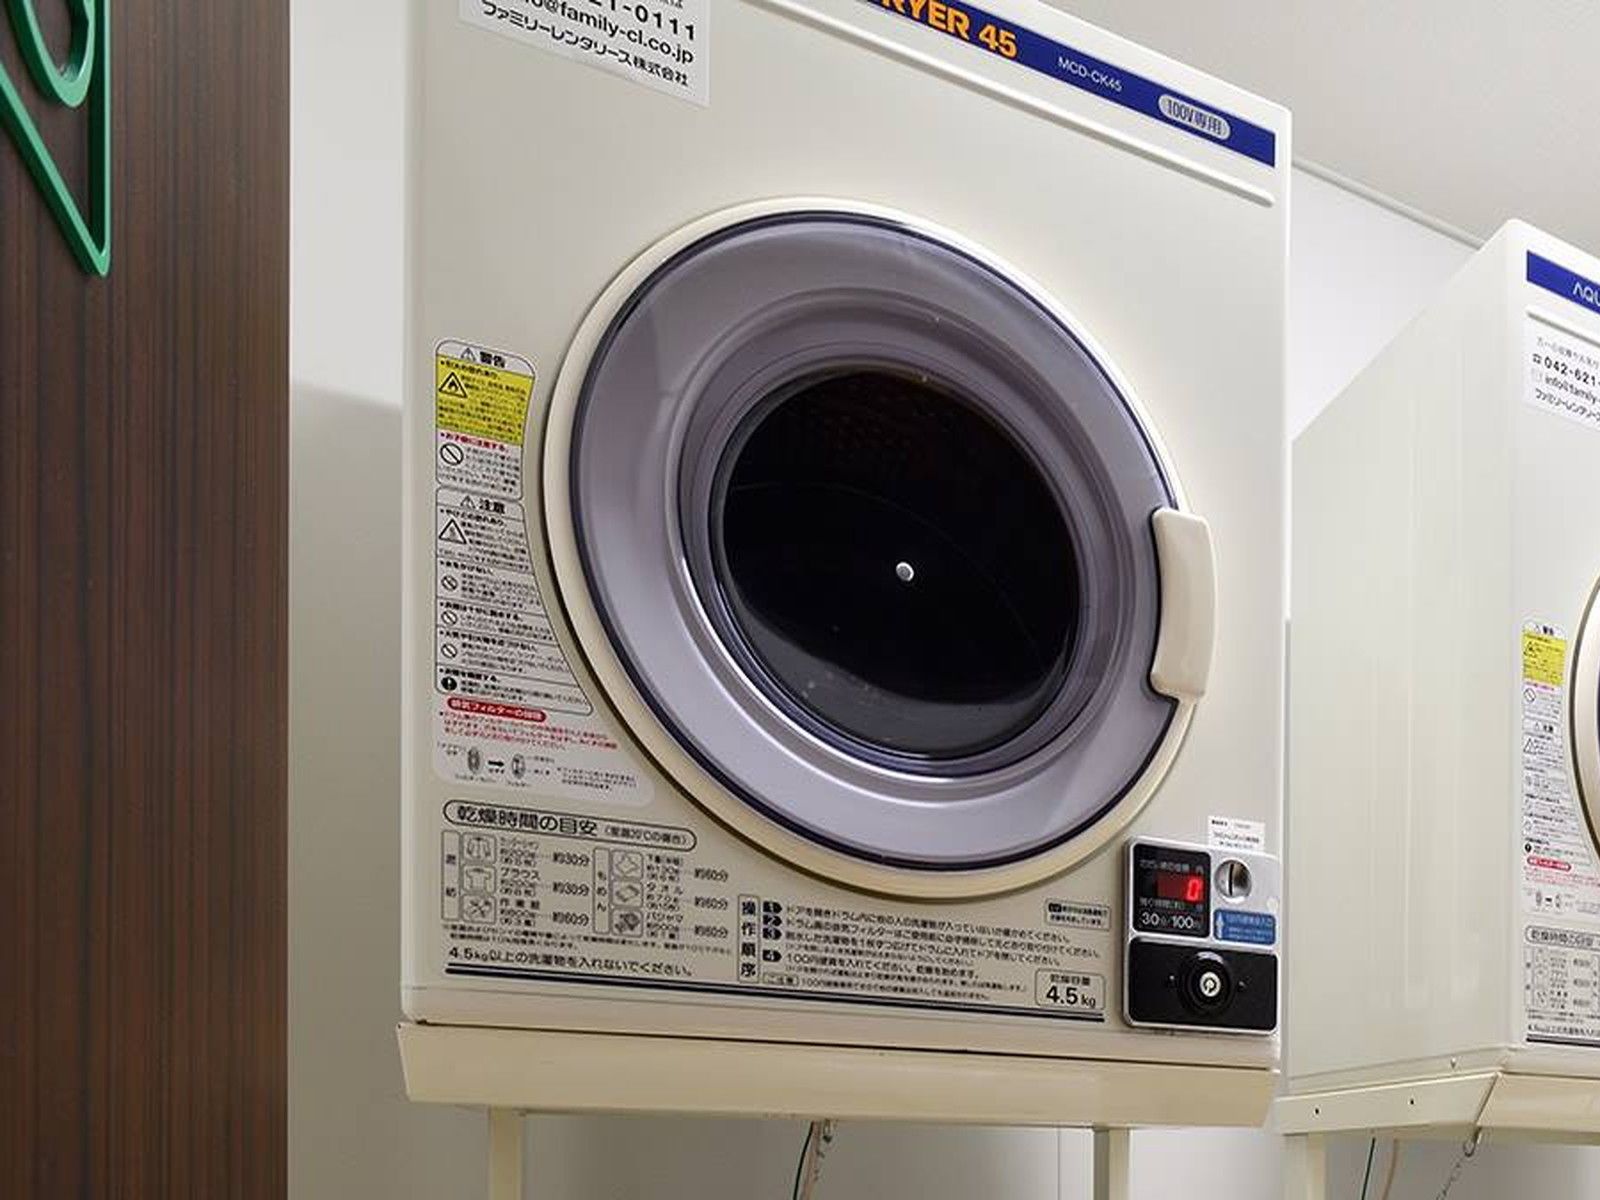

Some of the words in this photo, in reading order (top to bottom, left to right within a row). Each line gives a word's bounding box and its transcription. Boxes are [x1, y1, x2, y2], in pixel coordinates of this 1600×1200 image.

[979, 23, 1018, 58] 45
[1058, 56, 1122, 93] MCD-CK45
[457, 805, 598, 837] 乾燥時間の目安
[1187, 874, 1204, 903] 0
[1045, 986, 1079, 1006] 4.5
[1081, 994, 1097, 1009] kg
